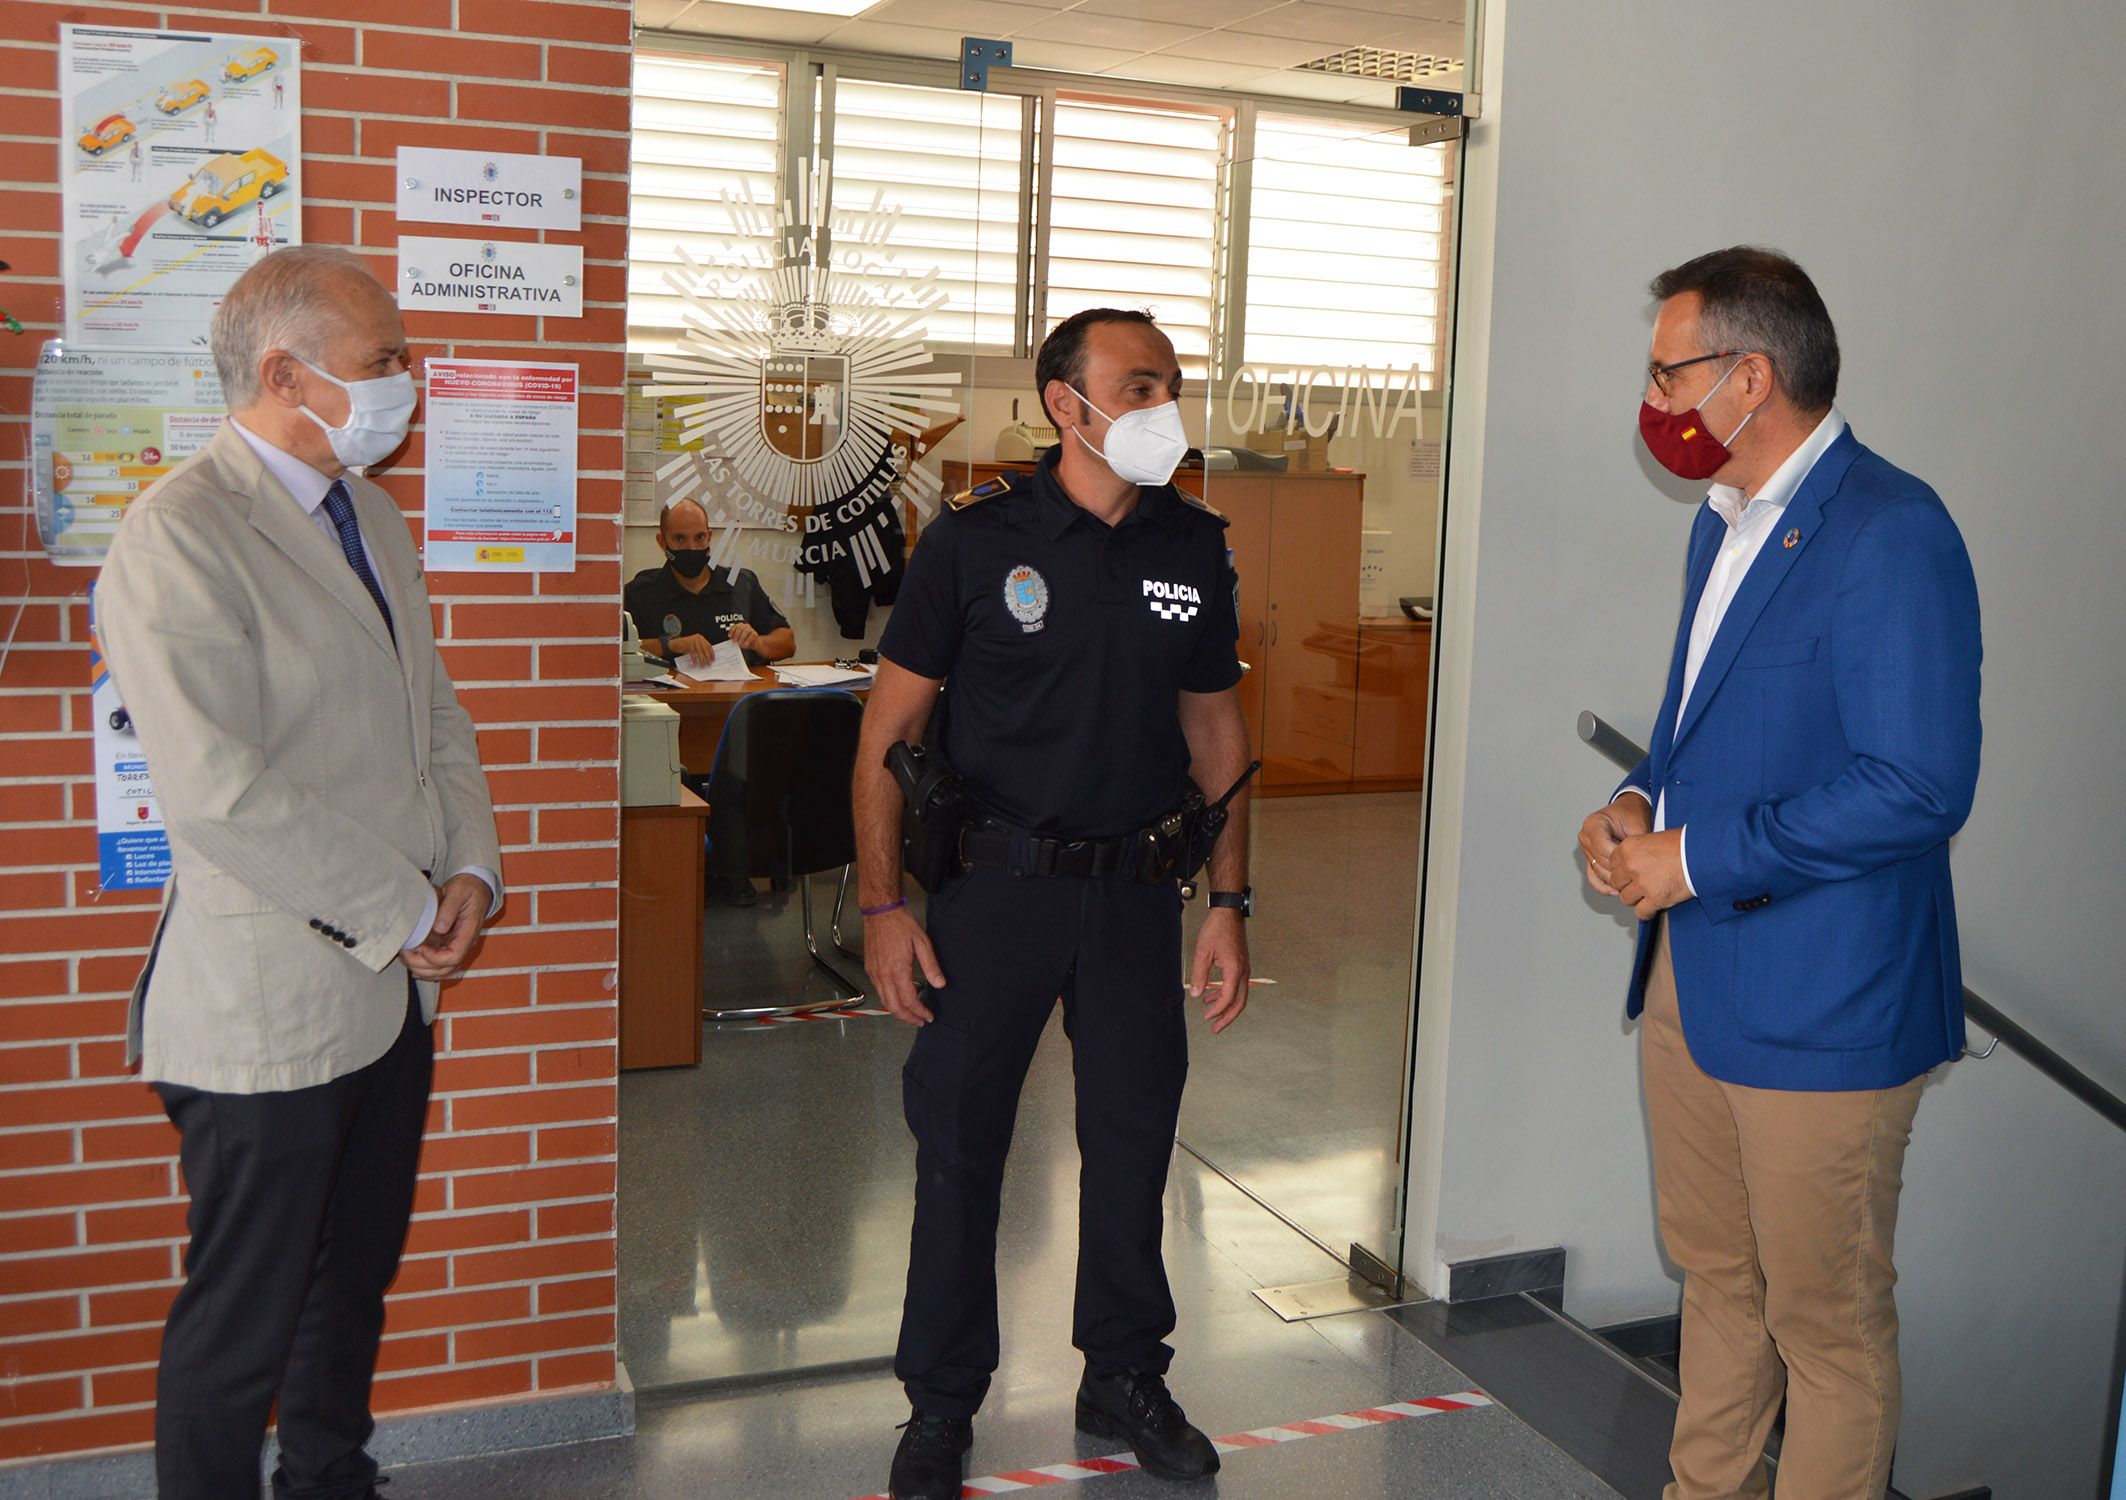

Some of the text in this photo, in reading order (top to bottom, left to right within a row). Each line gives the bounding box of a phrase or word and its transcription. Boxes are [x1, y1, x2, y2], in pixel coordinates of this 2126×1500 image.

[435, 187, 543, 208] INSPECTOR
[449, 263, 525, 281] OFICINA
[411, 282, 561, 302] ADMINISTRATIVA
[61, 353, 95, 366] km/h,
[113, 357, 125, 366] un
[128, 357, 166, 369] campo
[168, 356, 182, 366] de
[1227, 362, 1424, 440] OFICINA
[109, 468, 119, 477] 25
[127, 481, 137, 490] 33
[700, 443, 908, 534] LAS TORRES DE COTILLAS
[110, 510, 120, 518] 25
[750, 537, 848, 566] MURCIA
[1143, 579, 1202, 605] POLICIA
[715, 613, 745, 624] POLICIA
[117, 772, 150, 783] TORRES
